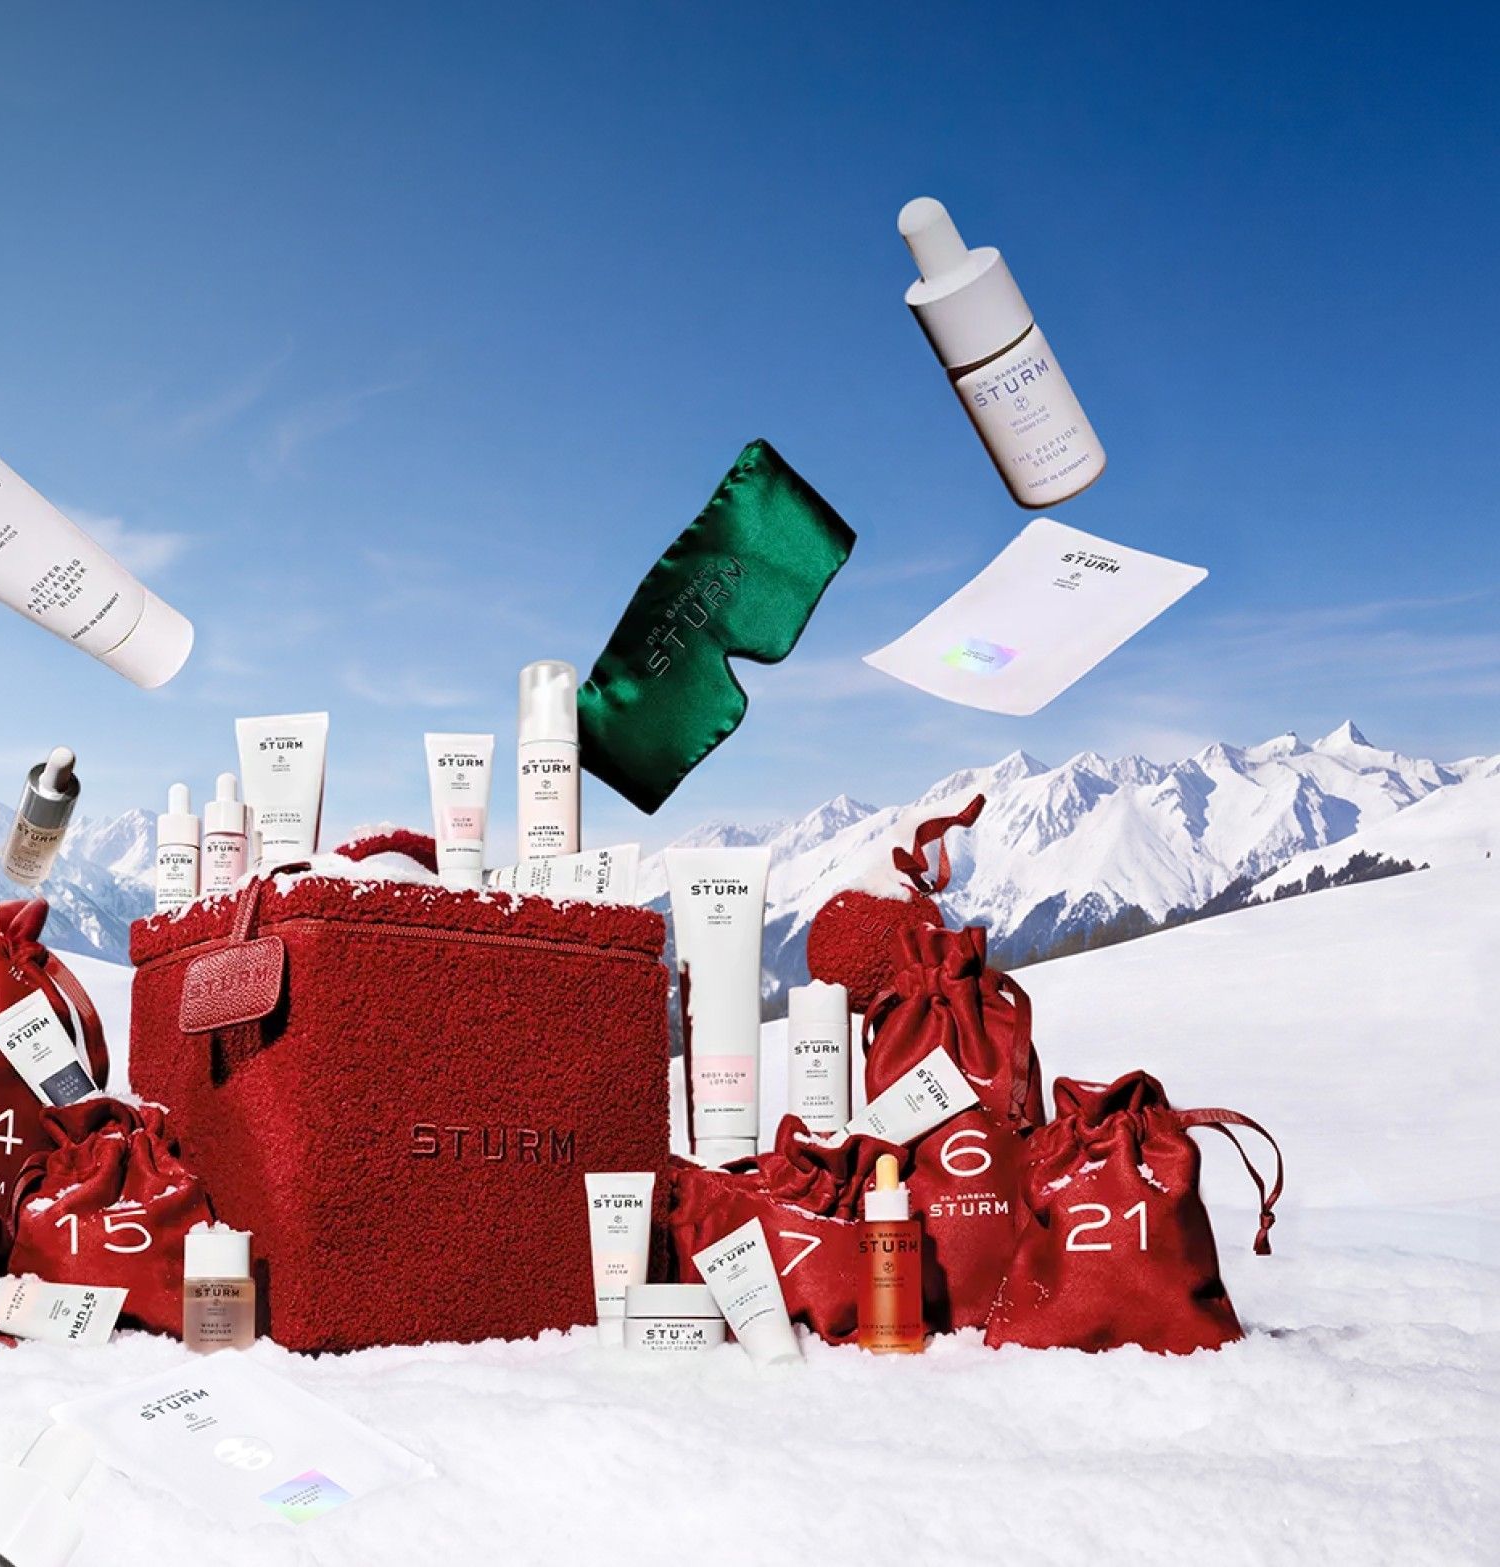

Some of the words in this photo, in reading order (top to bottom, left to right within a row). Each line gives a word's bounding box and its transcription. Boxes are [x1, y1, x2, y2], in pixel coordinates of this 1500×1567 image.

[974, 358, 1049, 408] STURM
[1036, 425, 1078, 455] PEPTIDE
[1033, 444, 1067, 467] SERUM
[1061, 553, 1120, 573] STURM
[28, 559, 80, 609] ANTI-AGING
[31, 565, 61, 594] SUPER
[36, 592, 62, 614] FACE
[62, 567, 87, 591] MASK
[58, 586, 82, 608] RICH
[647, 556, 749, 677] STURM
[259, 741, 303, 751] STURM
[438, 758, 484, 767] STURM
[522, 764, 571, 775] STURM
[596, 851, 609, 894] STURM
[691, 885, 748, 895] STURM
[7, 1017, 50, 1050] STURM
[794, 1045, 840, 1055] STURM
[916, 1069, 949, 1111] STURM
[411, 1123, 577, 1164] STURM
[940, 1129, 992, 1178] 6
[594, 1199, 643, 1208] STURM
[929, 1200, 1009, 1217] STURM
[956, 1192, 996, 1200] BARBARA
[54, 1209, 153, 1255] 15
[1065, 1200, 1148, 1251] 21
[707, 1241, 756, 1274] STURM
[779, 1230, 822, 1277] 7
[859, 1240, 919, 1253] STURM
[195, 1288, 240, 1298] STURM
[68, 1292, 95, 1339] STURM
[646, 1329, 703, 1340] STUM
[140, 1388, 209, 1420] STURM
